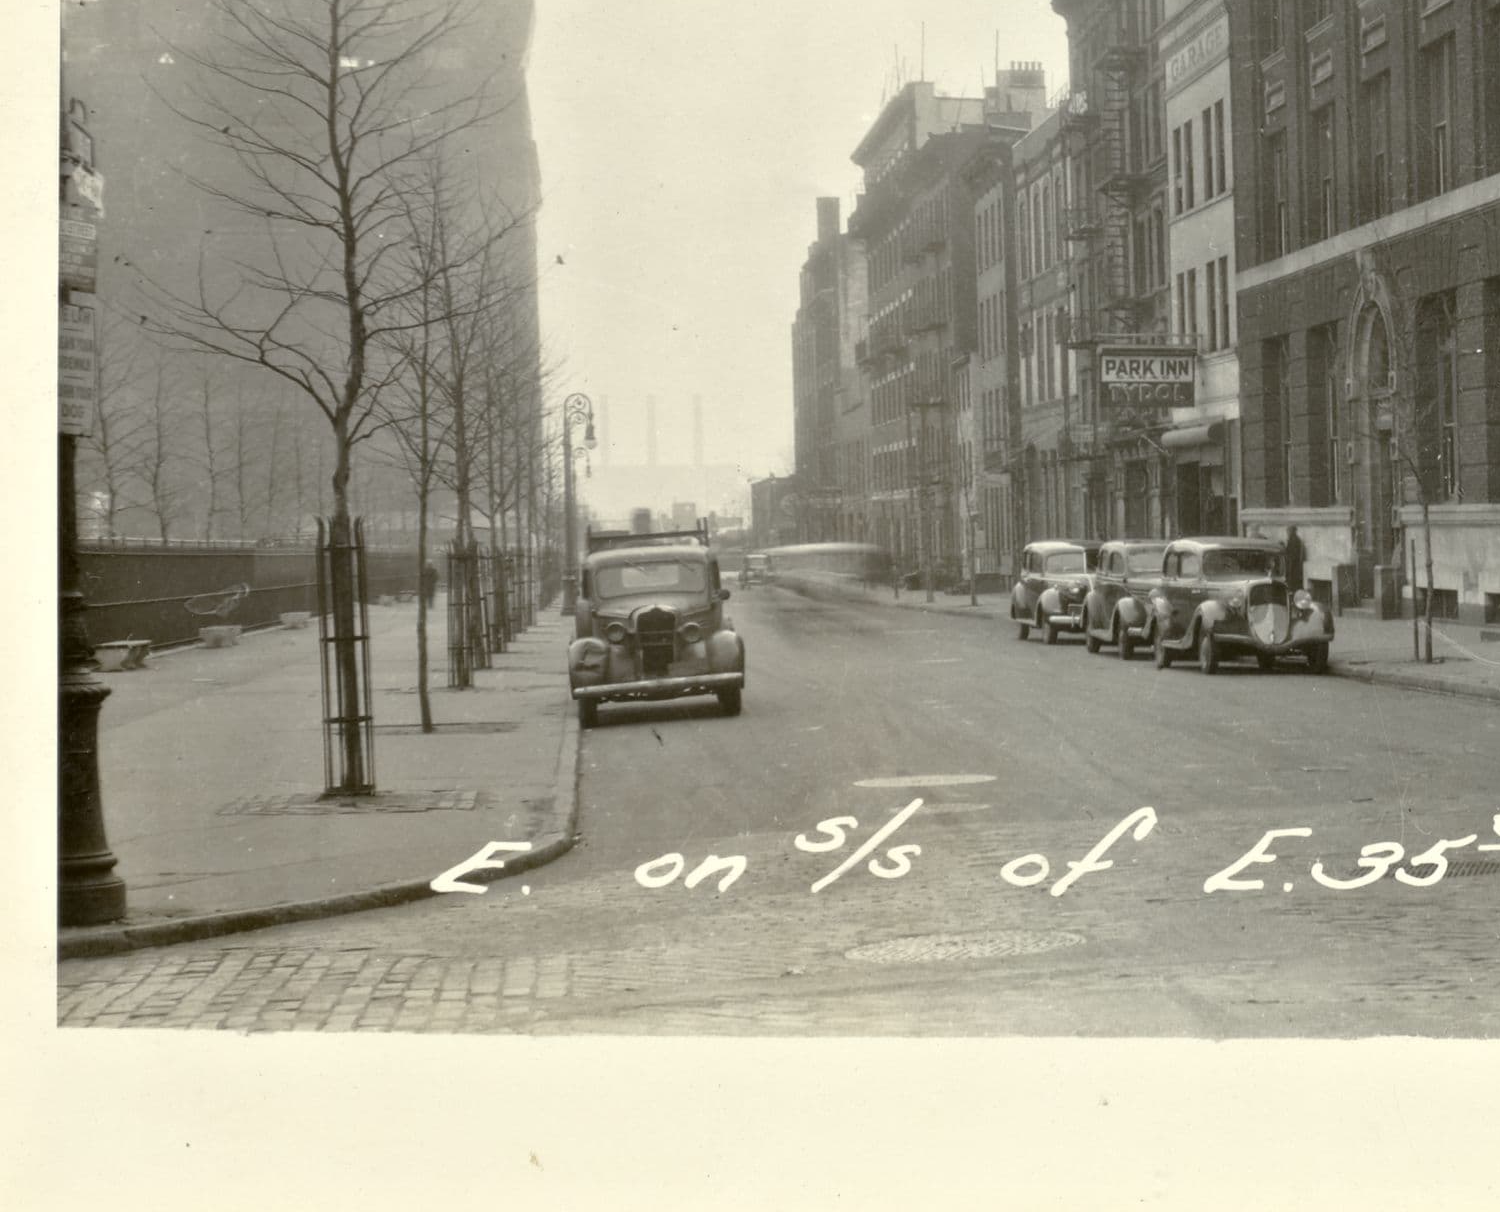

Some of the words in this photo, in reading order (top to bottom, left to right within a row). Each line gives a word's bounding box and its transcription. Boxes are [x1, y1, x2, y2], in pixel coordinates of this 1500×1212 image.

[1171, 25, 1223, 81] GARAGE
[1105, 359, 1157, 378] PARK
[1160, 359, 1190, 378] INN
